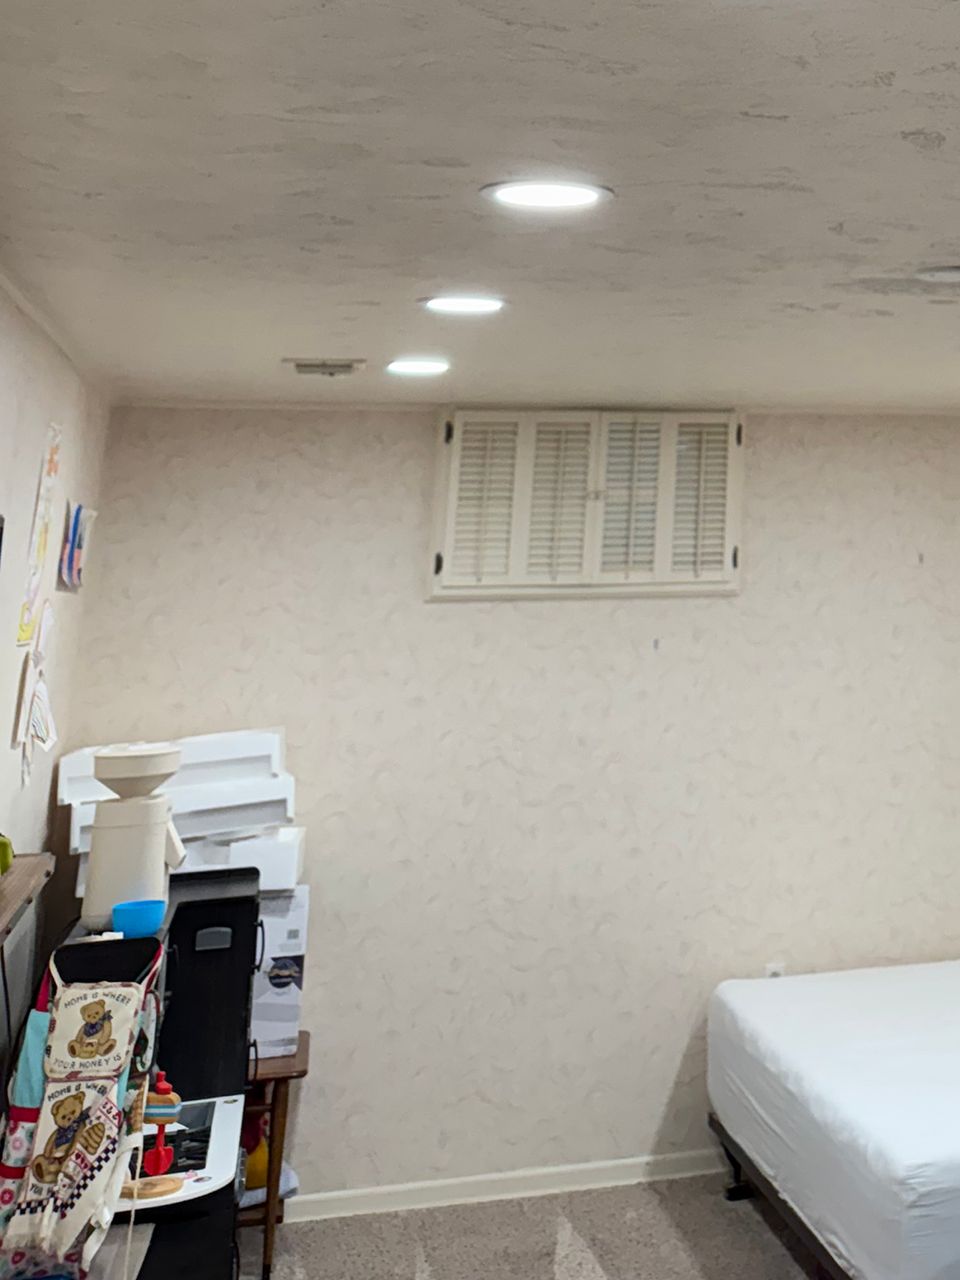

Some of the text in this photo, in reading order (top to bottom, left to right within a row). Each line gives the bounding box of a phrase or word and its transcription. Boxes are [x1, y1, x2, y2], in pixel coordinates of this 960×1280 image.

[64, 990, 131, 1008] HOME IS WHERE
[53, 1058, 76, 1069] YOUR
[79, 1057, 111, 1069] HONEY
[48, 1084, 71, 1101] HOME
